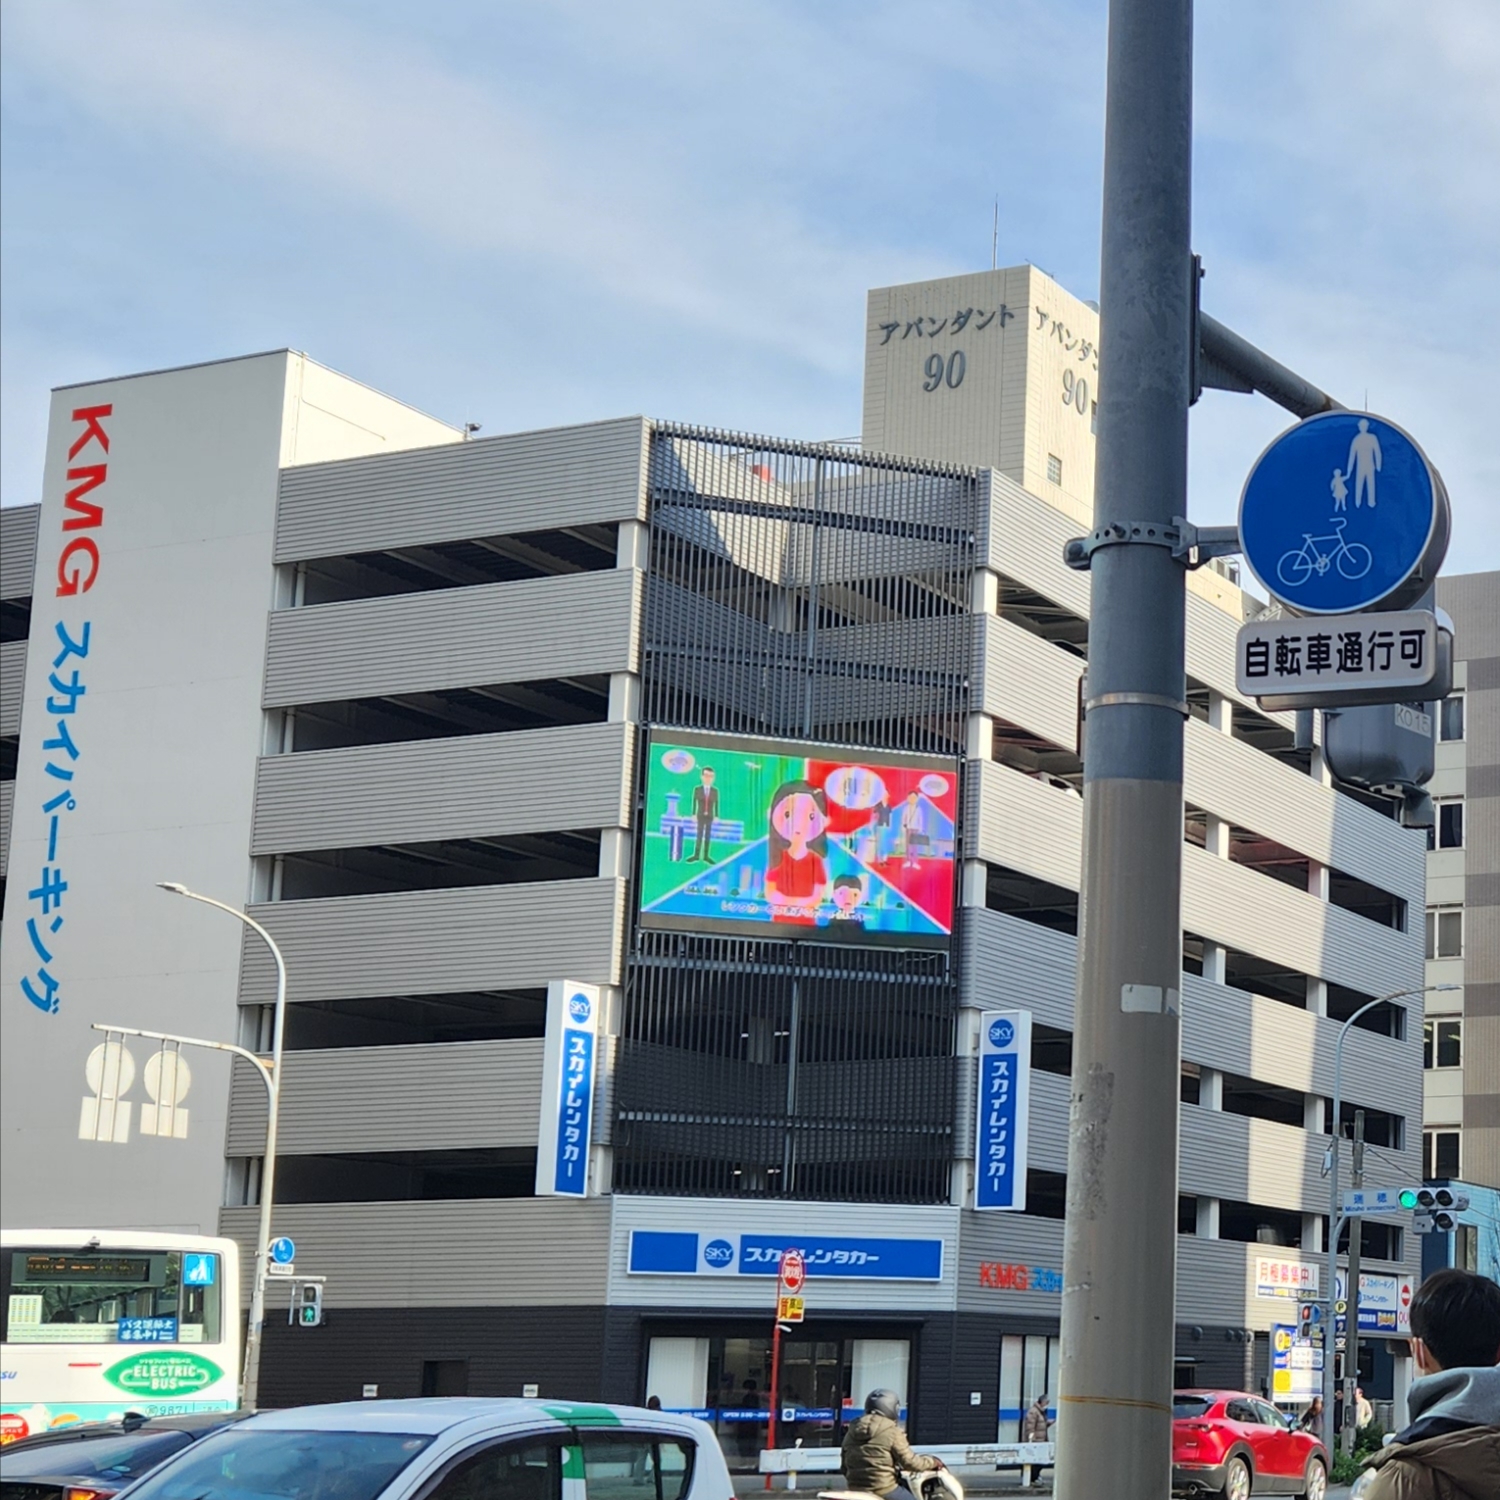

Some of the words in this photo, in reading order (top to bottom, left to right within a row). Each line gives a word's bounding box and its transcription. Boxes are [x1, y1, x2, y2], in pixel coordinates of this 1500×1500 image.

[878, 303, 1015, 346] アバンダント
[922, 350, 967, 393] 90
[1061, 368, 1088, 416] 90
[56, 403, 113, 597] KMG
[1244, 628, 1427, 678] 自転車通行可
[19, 620, 91, 1015] スカイパーキング
[569, 999, 591, 1013] SKY
[989, 1027, 1014, 1038] SKY
[562, 1037, 586, 1178] スカイレンタカー
[987, 1061, 1010, 1192] スカイレンタカー
[705, 1247, 733, 1258] SKY
[979, 1262, 1028, 1291] KMG
[132, 1364, 198, 1378] ELECTRIC
[151, 1377, 178, 1391] BUS
